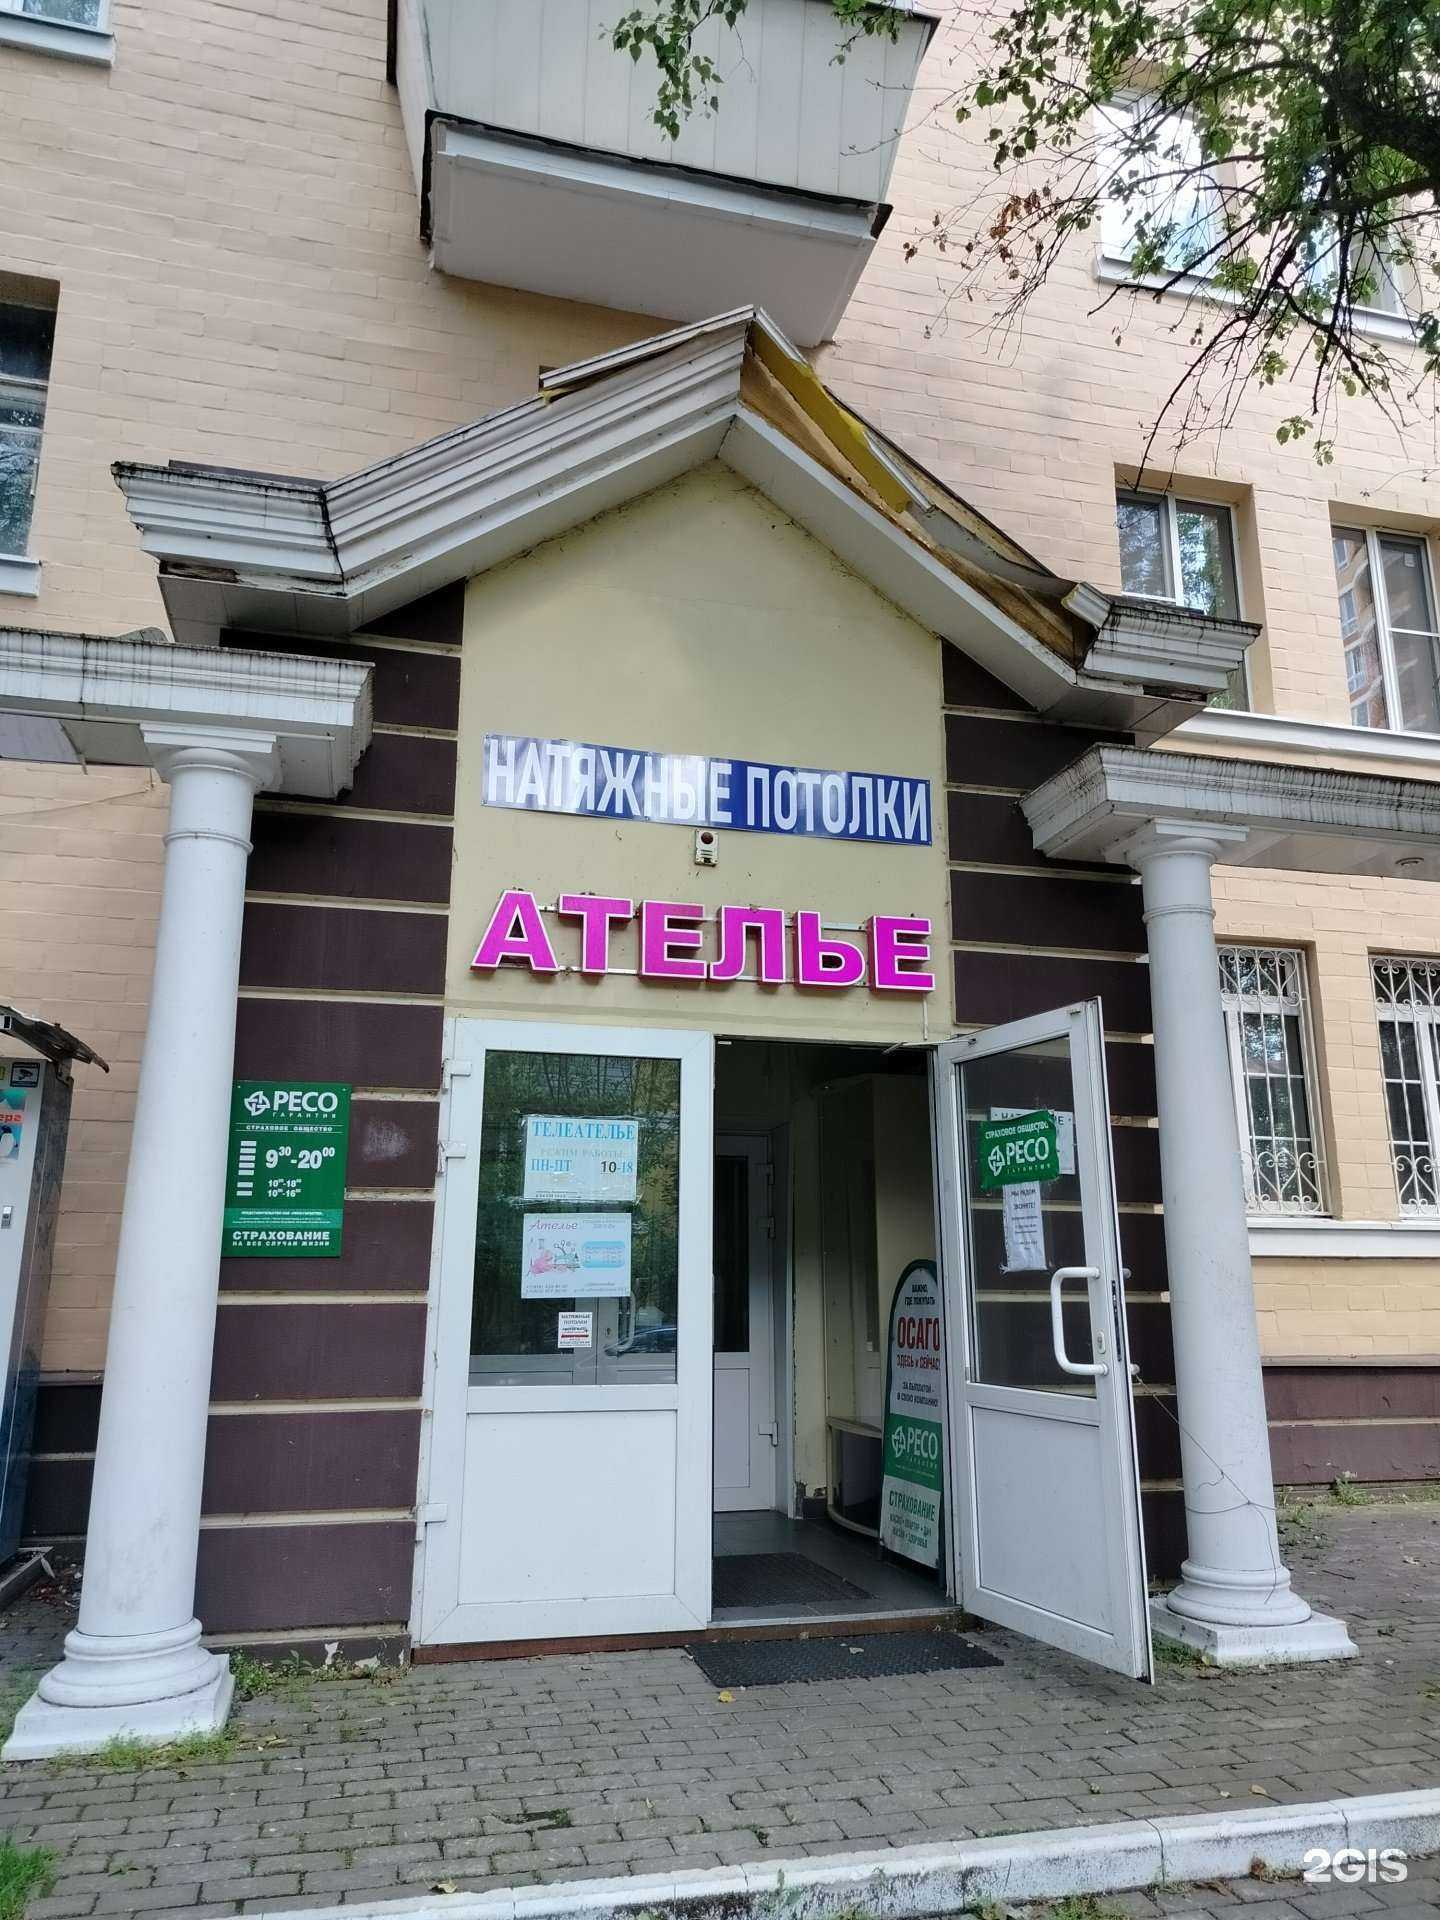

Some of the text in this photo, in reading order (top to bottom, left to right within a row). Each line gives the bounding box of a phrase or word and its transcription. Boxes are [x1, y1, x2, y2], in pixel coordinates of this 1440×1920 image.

[486, 737, 929, 842] НАТЯЖНЫЕ ПОТОЛКИ
[470, 888, 936, 993] АТЕЛЬЕ
[273, 1090, 338, 1112] РЕСО
[532, 1121, 635, 1140] ТЕЛЕАТЕЛЬЕ
[1006, 1136, 1050, 1165] РЕСО
[530, 1159, 633, 1173] ПН-ПТ 10-18
[232, 1231, 330, 1240] СТРАХОВАНИЕ
[897, 1316, 940, 1352] ОСАГО
[906, 1427, 938, 1460] РЕСО
[889, 1490, 935, 1522] СТРАХОВАНИЕ
